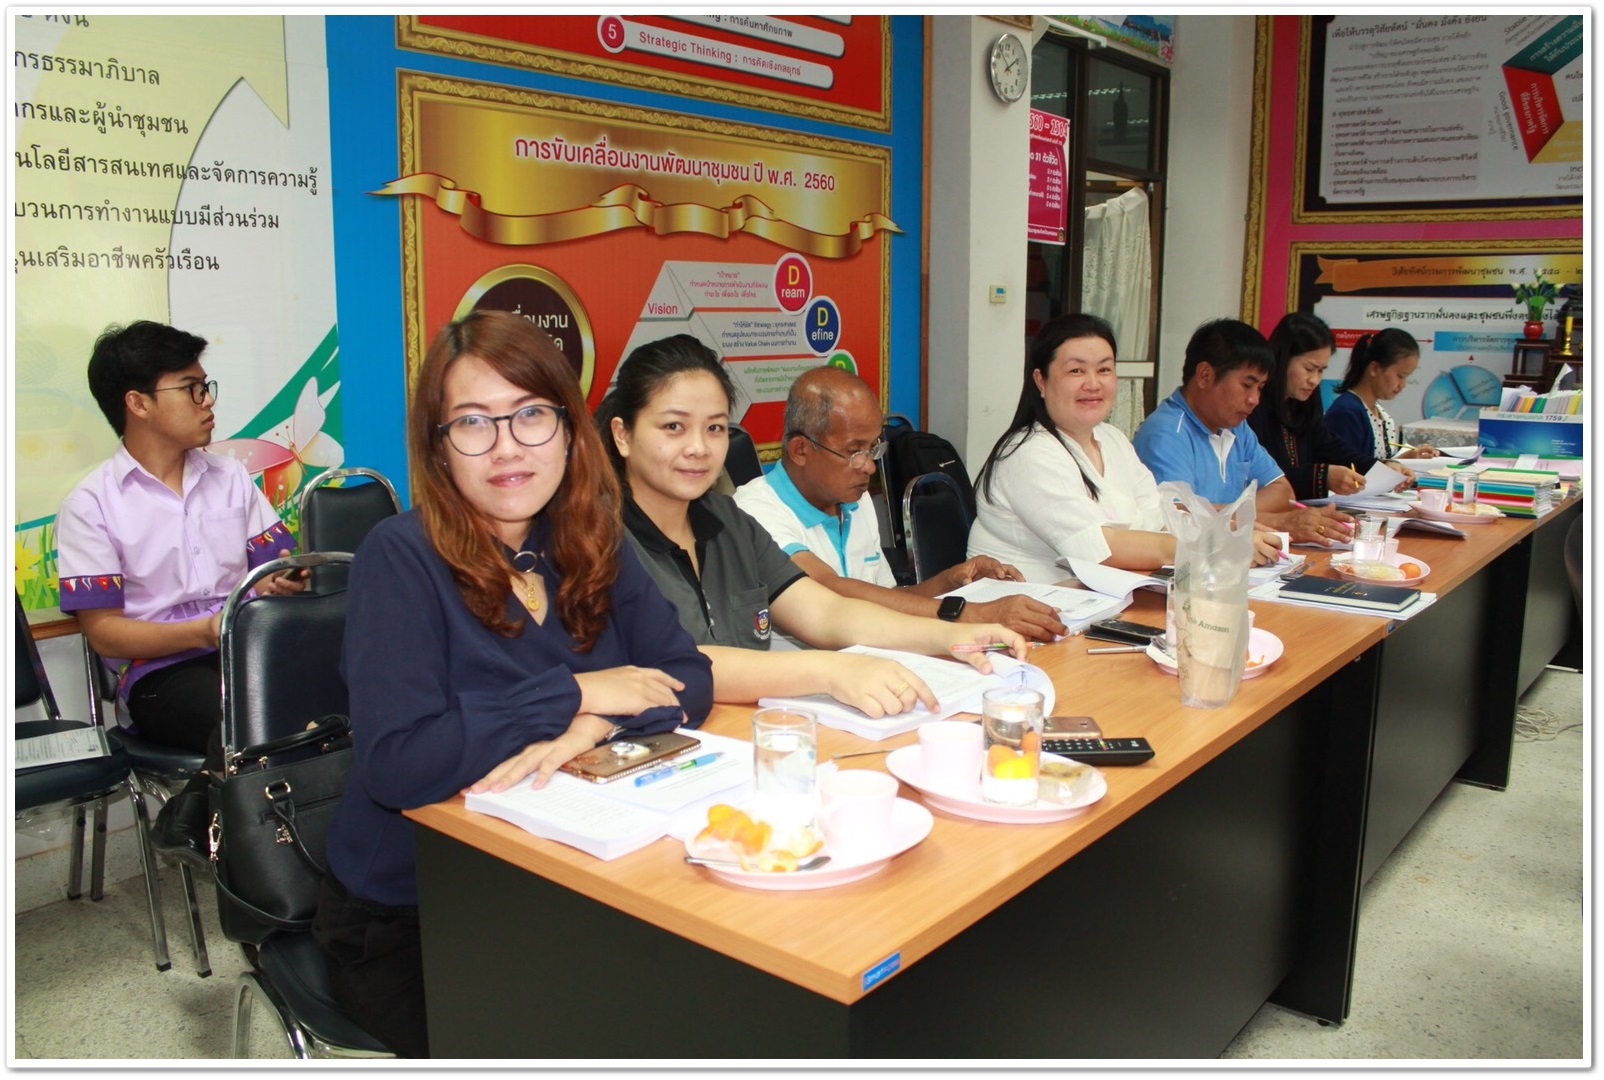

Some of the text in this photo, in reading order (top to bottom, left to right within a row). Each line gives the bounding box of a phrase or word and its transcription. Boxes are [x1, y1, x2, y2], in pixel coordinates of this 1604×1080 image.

[608, 23, 618, 40] 5
[639, 31, 687, 53] Strategic
[690, 42, 732, 64] Thinking
[15, 144, 319, 196] นโลยีสารสนเทศและจัดการความรู้
[514, 136, 836, 192] การขับเคลื่อนงานพัฒนาชุมชน ปี พ.ศ. 2560
[788, 265, 800, 285] D
[781, 288, 805, 299] ream
[647, 302, 678, 315] Vision
[817, 306, 829, 327] D
[811, 328, 834, 341] efine
[1198, 620, 1230, 633] Amazon
